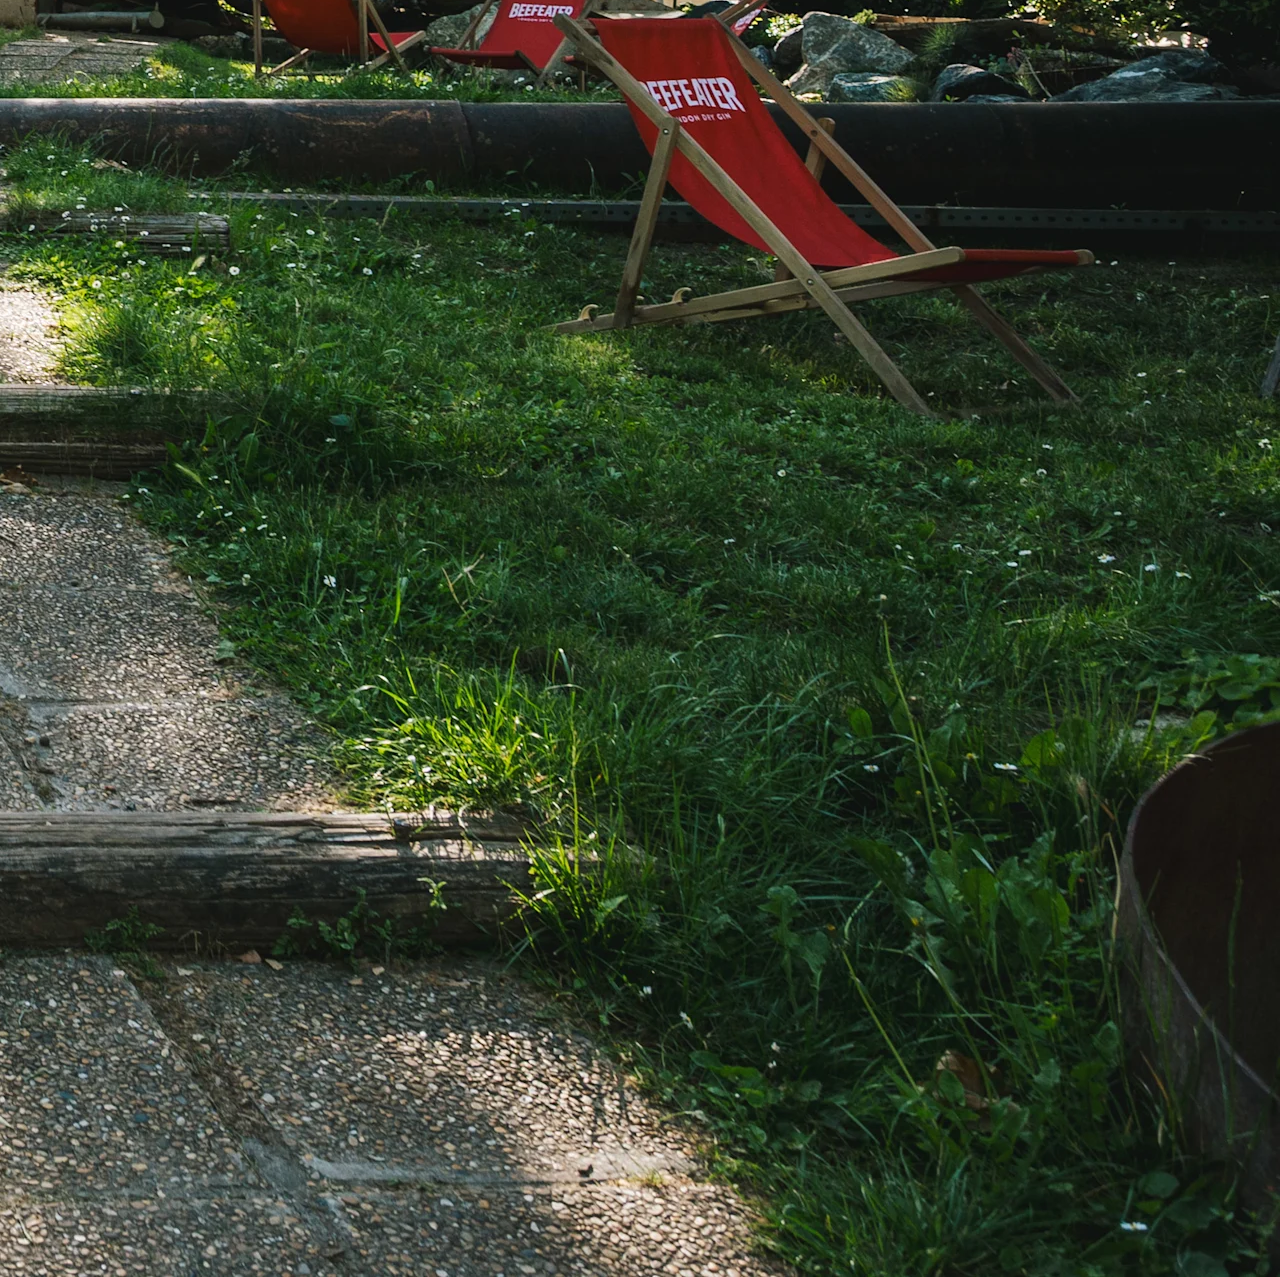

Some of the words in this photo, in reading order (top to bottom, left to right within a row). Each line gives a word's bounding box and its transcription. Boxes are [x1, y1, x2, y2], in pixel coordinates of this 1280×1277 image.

[638, 77, 746, 113] EEFEATER
[701, 113, 716, 122] DRY
[716, 112, 732, 121] GIN
